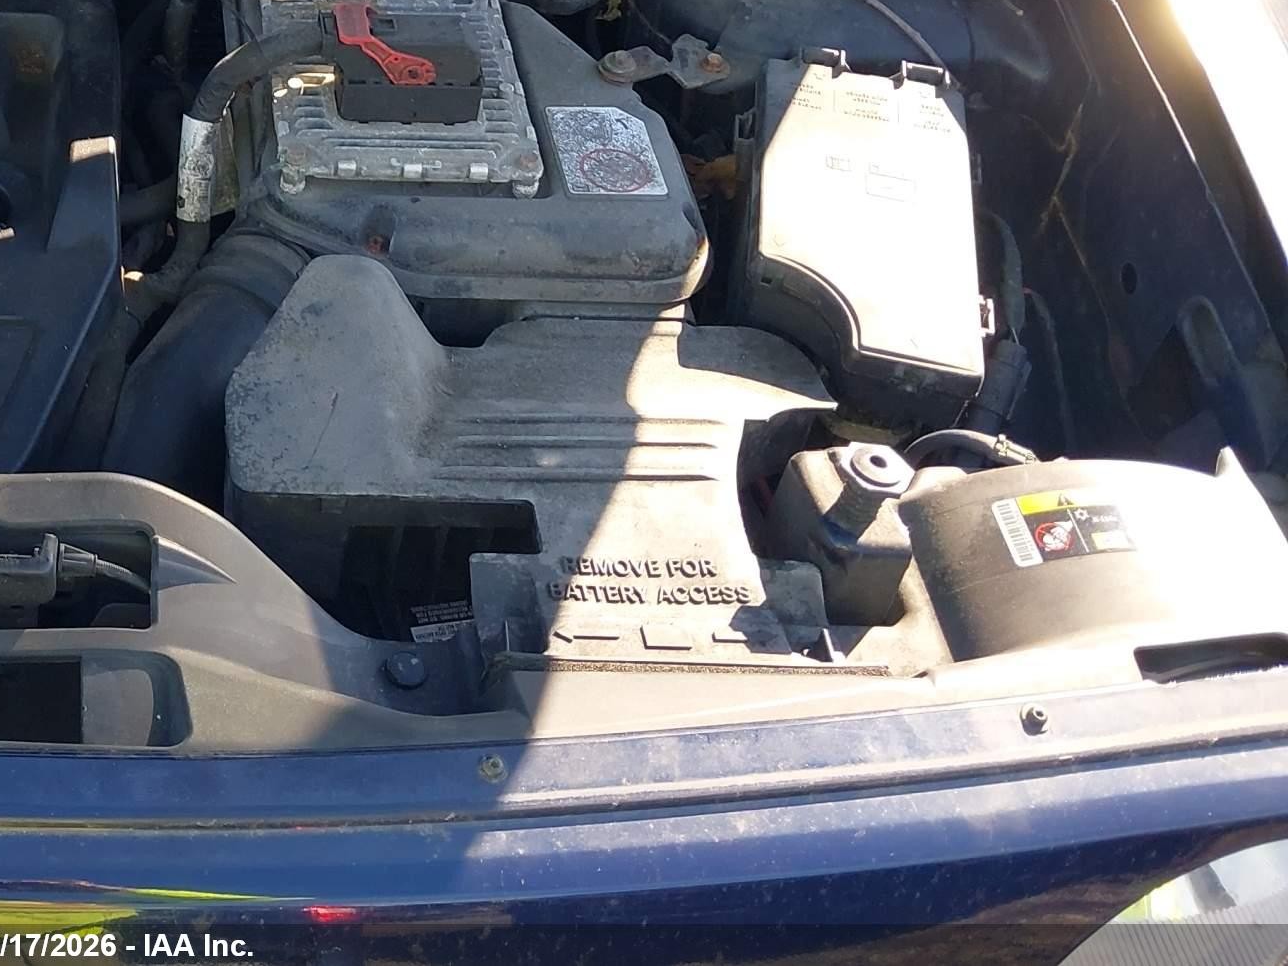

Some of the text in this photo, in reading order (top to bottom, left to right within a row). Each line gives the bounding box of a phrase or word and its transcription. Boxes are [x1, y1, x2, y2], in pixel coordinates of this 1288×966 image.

[561, 555, 718, 579] REMOVE FOR
[549, 581, 752, 605] BATTERY ACCESS
